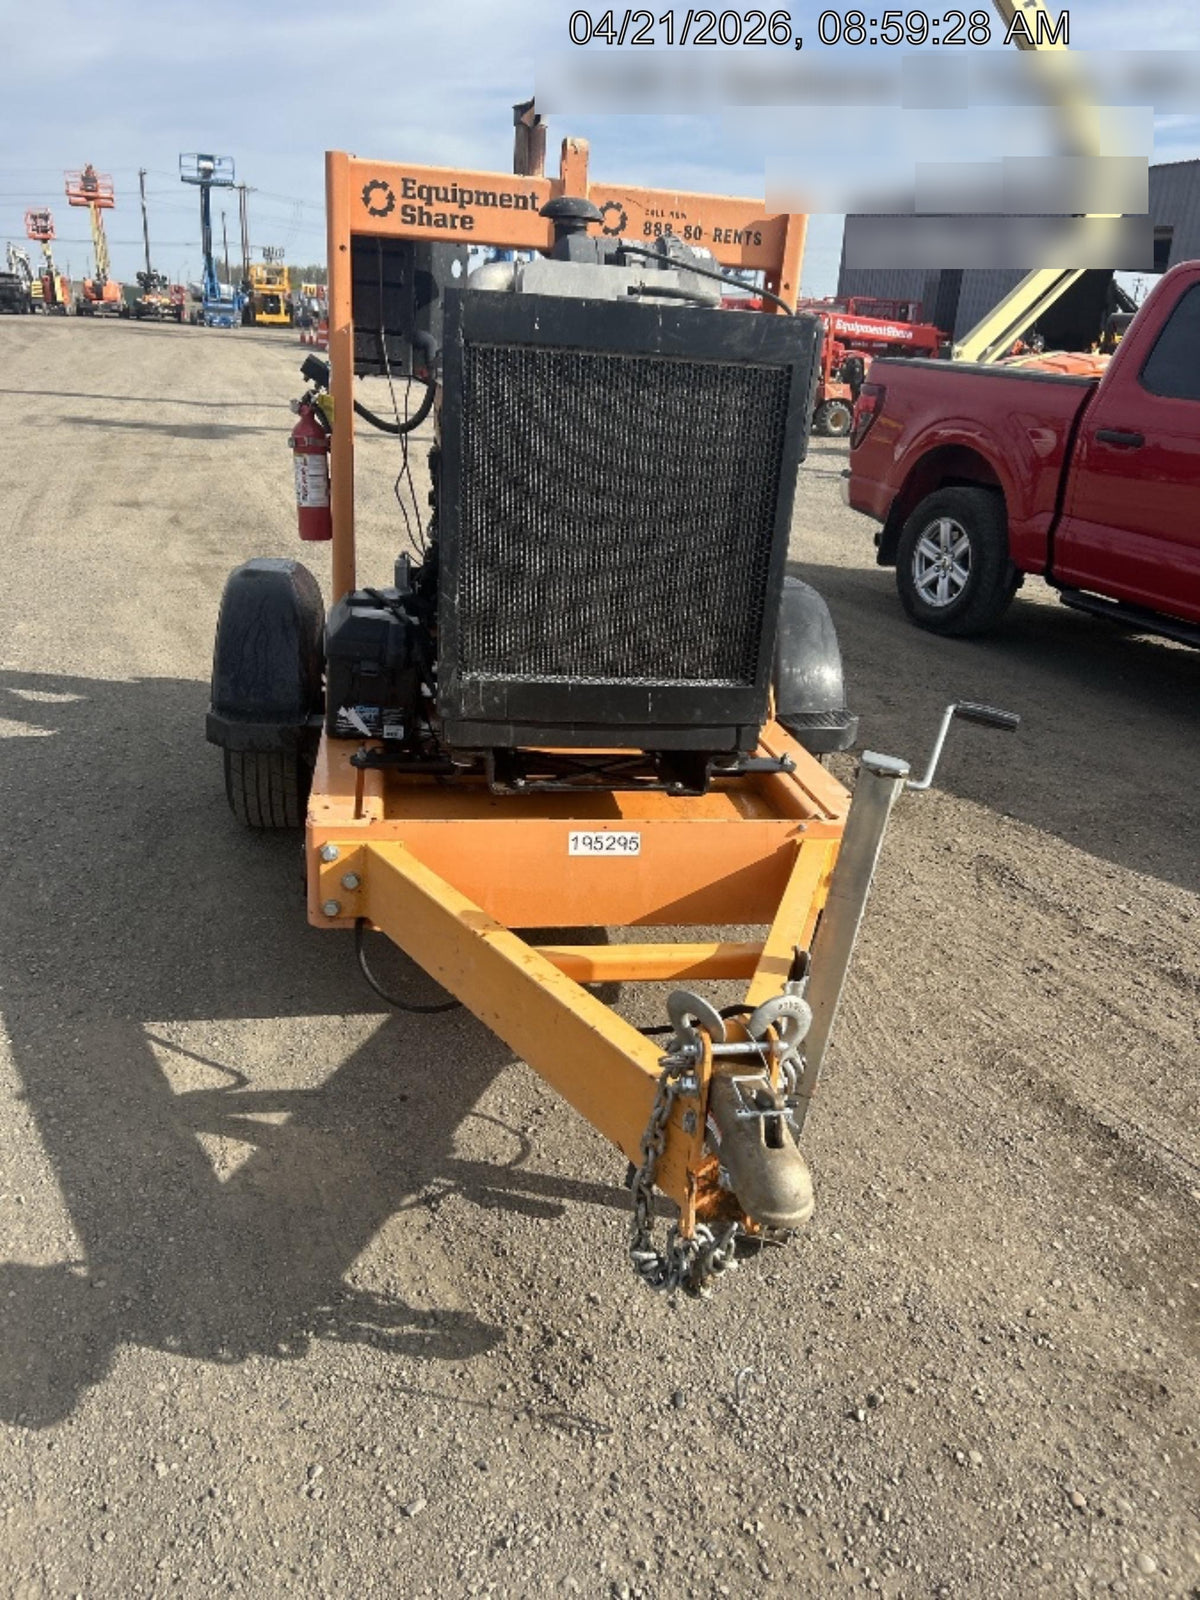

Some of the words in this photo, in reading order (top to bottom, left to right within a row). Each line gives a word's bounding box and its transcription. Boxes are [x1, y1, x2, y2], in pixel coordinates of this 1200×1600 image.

[401, 177, 540, 212] Equipment
[401, 204, 475, 230] Share
[571, 835, 639, 851] 195295
